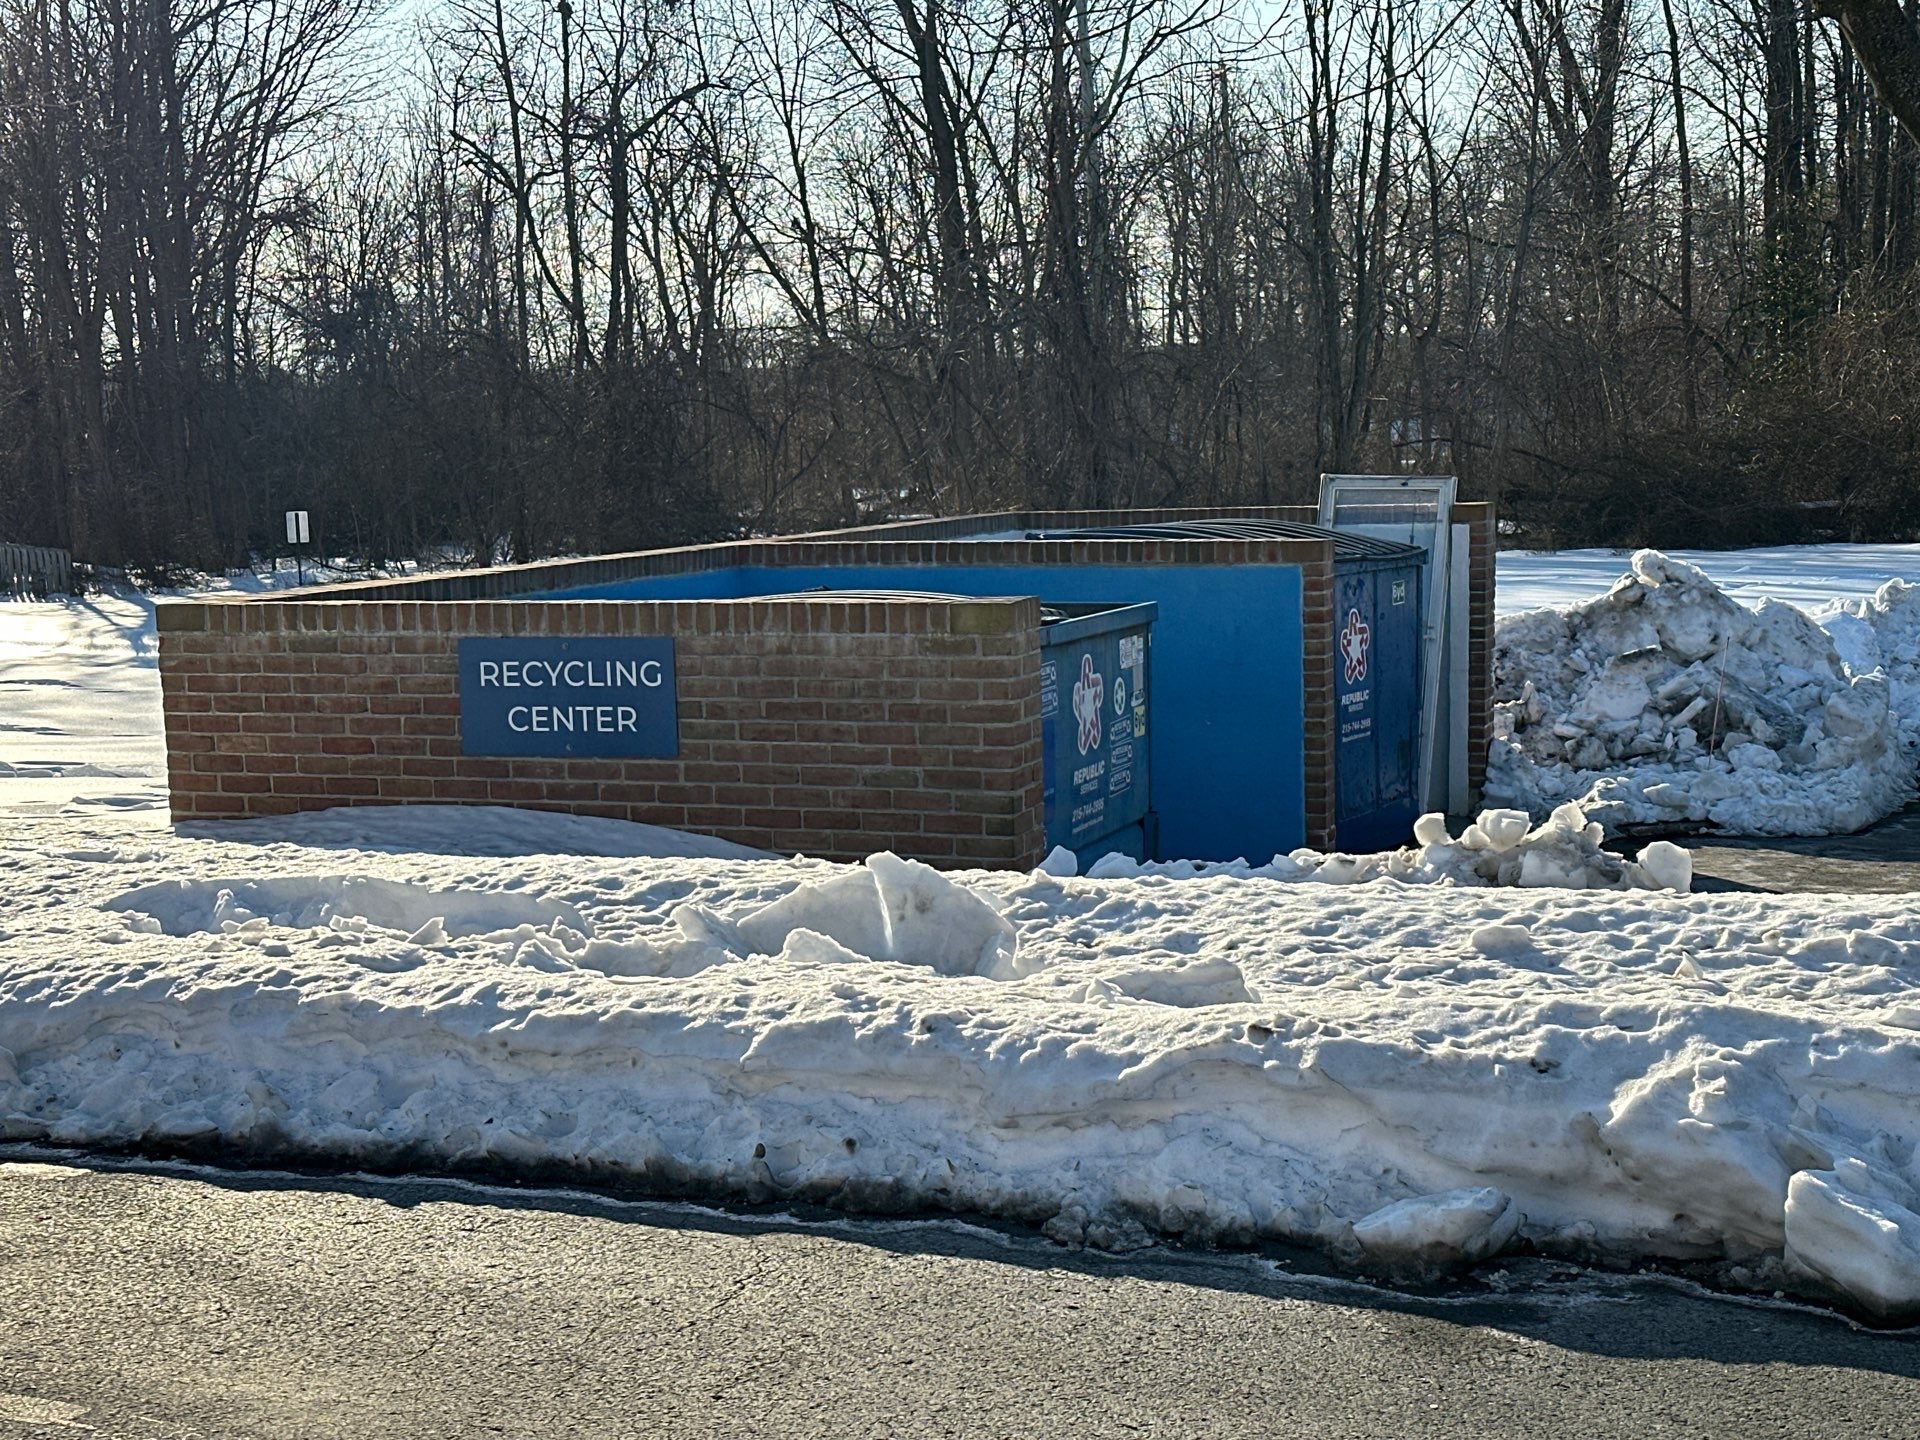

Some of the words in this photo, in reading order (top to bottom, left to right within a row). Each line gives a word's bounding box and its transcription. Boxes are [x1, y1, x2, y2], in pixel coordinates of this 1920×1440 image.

[480, 660, 662, 687] RECYCLING
[1342, 690, 1370, 706] REPUBLIC
[508, 706, 638, 732] CENTER
[1074, 760, 1105, 785] REPUBLIC
